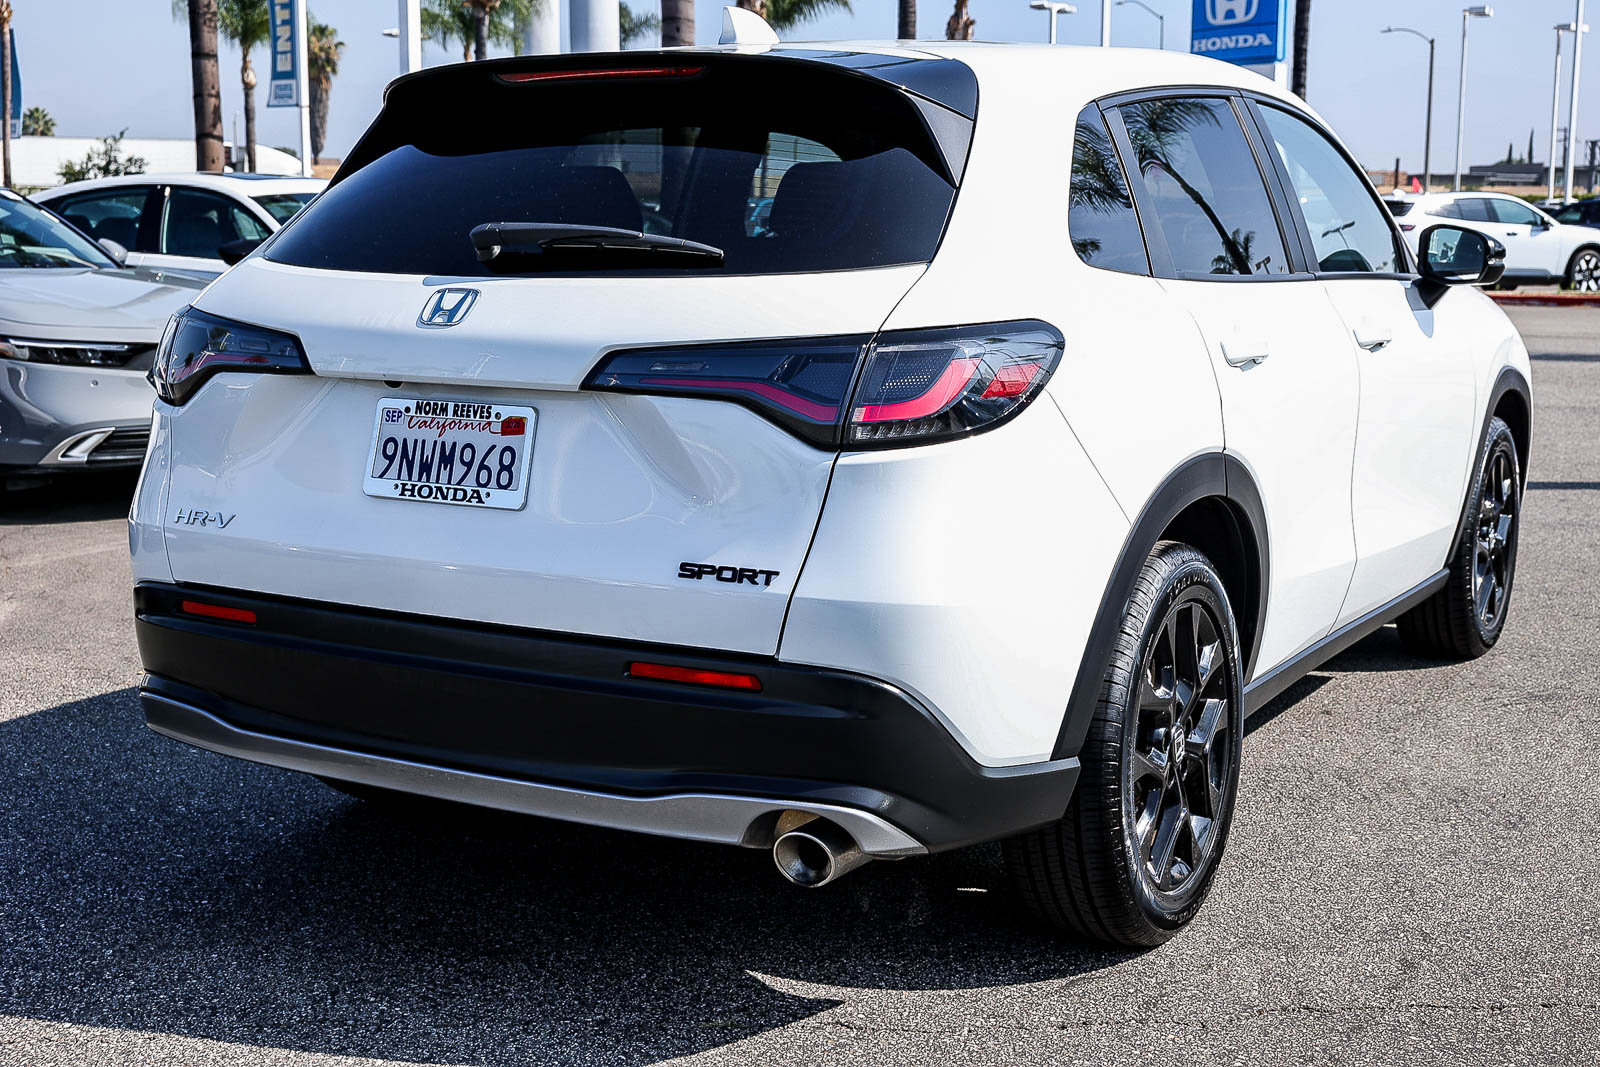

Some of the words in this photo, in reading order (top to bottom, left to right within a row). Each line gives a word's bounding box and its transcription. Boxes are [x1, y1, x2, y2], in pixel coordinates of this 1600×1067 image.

[275, 0, 292, 71] ENT
[1192, 32, 1273, 53] HONDA
[384, 409, 403, 423] SEP
[414, 400, 449, 417] NORM
[452, 404, 493, 420] REEVES
[407, 415, 502, 438] California
[378, 436, 517, 490] 9NWM968
[398, 482, 486, 505] HONDA
[173, 507, 237, 529] HR-V
[677, 561, 781, 587] SPORT
